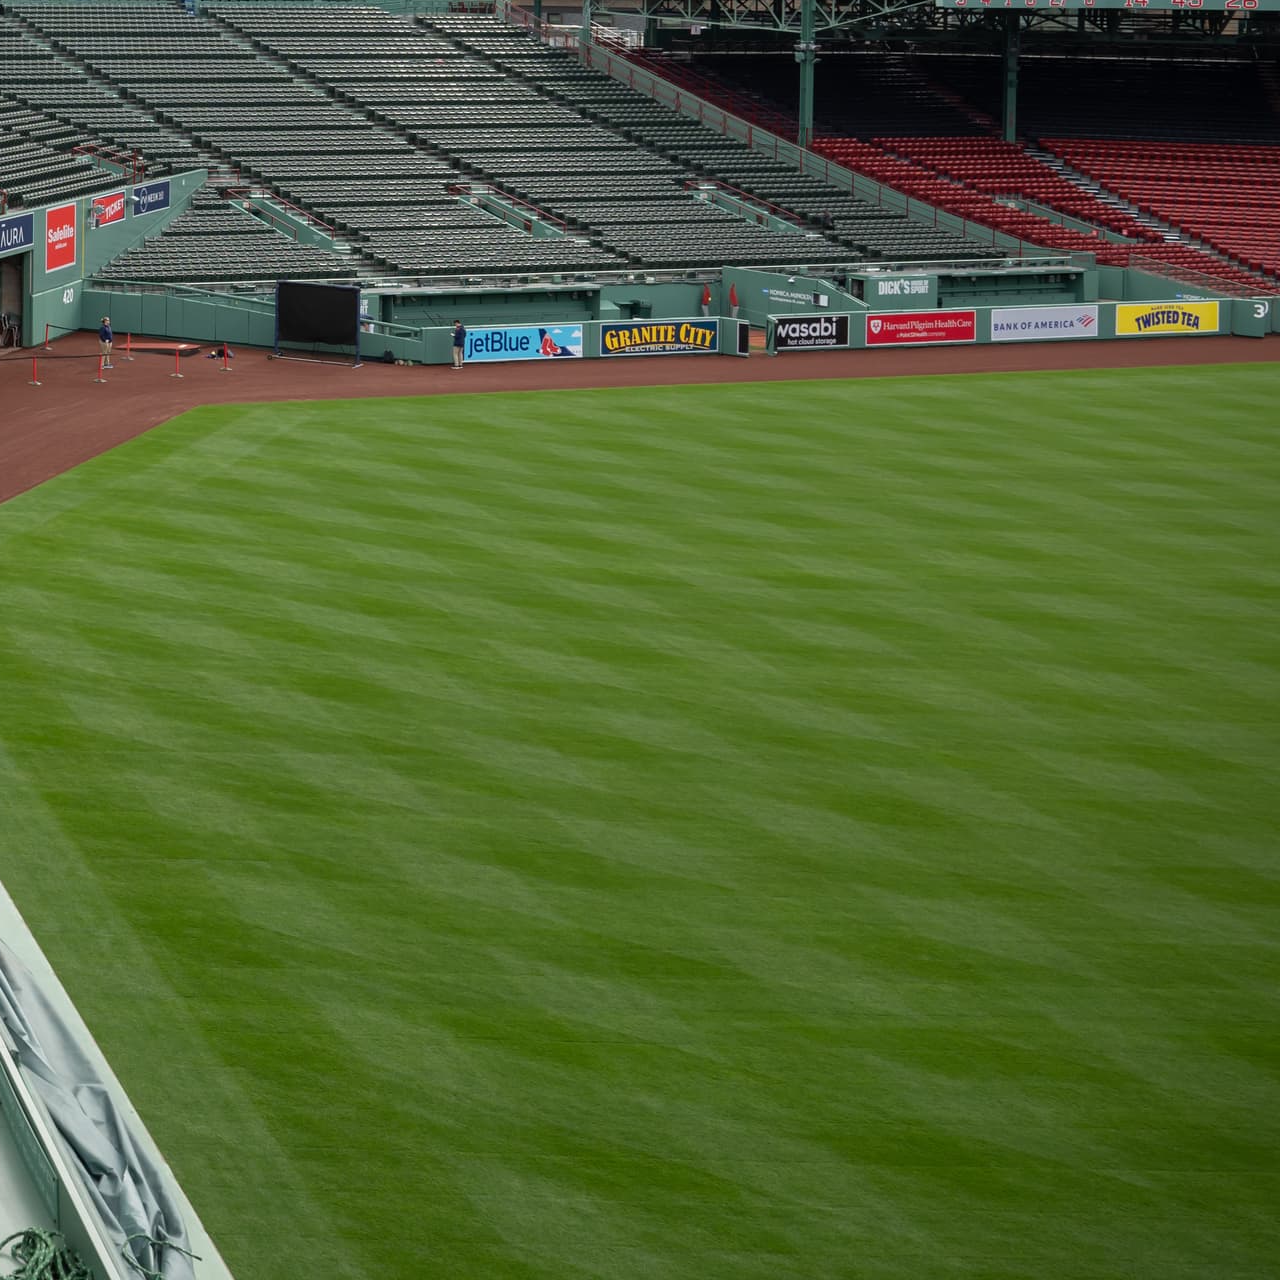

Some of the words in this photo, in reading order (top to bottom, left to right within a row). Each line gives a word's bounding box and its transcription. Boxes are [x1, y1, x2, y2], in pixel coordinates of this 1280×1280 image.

[47, 224, 74, 244] Safelite
[62, 287, 75, 305] 420
[878, 279, 911, 296] DICK'S
[883, 320, 910, 331] Harvard
[910, 320, 934, 331] Pilgrim
[934, 319, 957, 329] Health
[957, 319, 972, 328] Care
[993, 322, 1018, 332] BANK
[1020, 322, 1033, 330] OF
[1034, 320, 1075, 329] AMERICA
[1134, 310, 1180, 332] TWISTED
[1181, 311, 1200, 330] TEA
[467, 331, 530, 358] jetBlue
[604, 324, 677, 351] GRANITE
[679, 323, 715, 348] CITY
[787, 338, 798, 346] hot
[798, 337, 814, 345] cloud
[815, 337, 837, 346] storage
[625, 345, 663, 353] ELECTRIC
